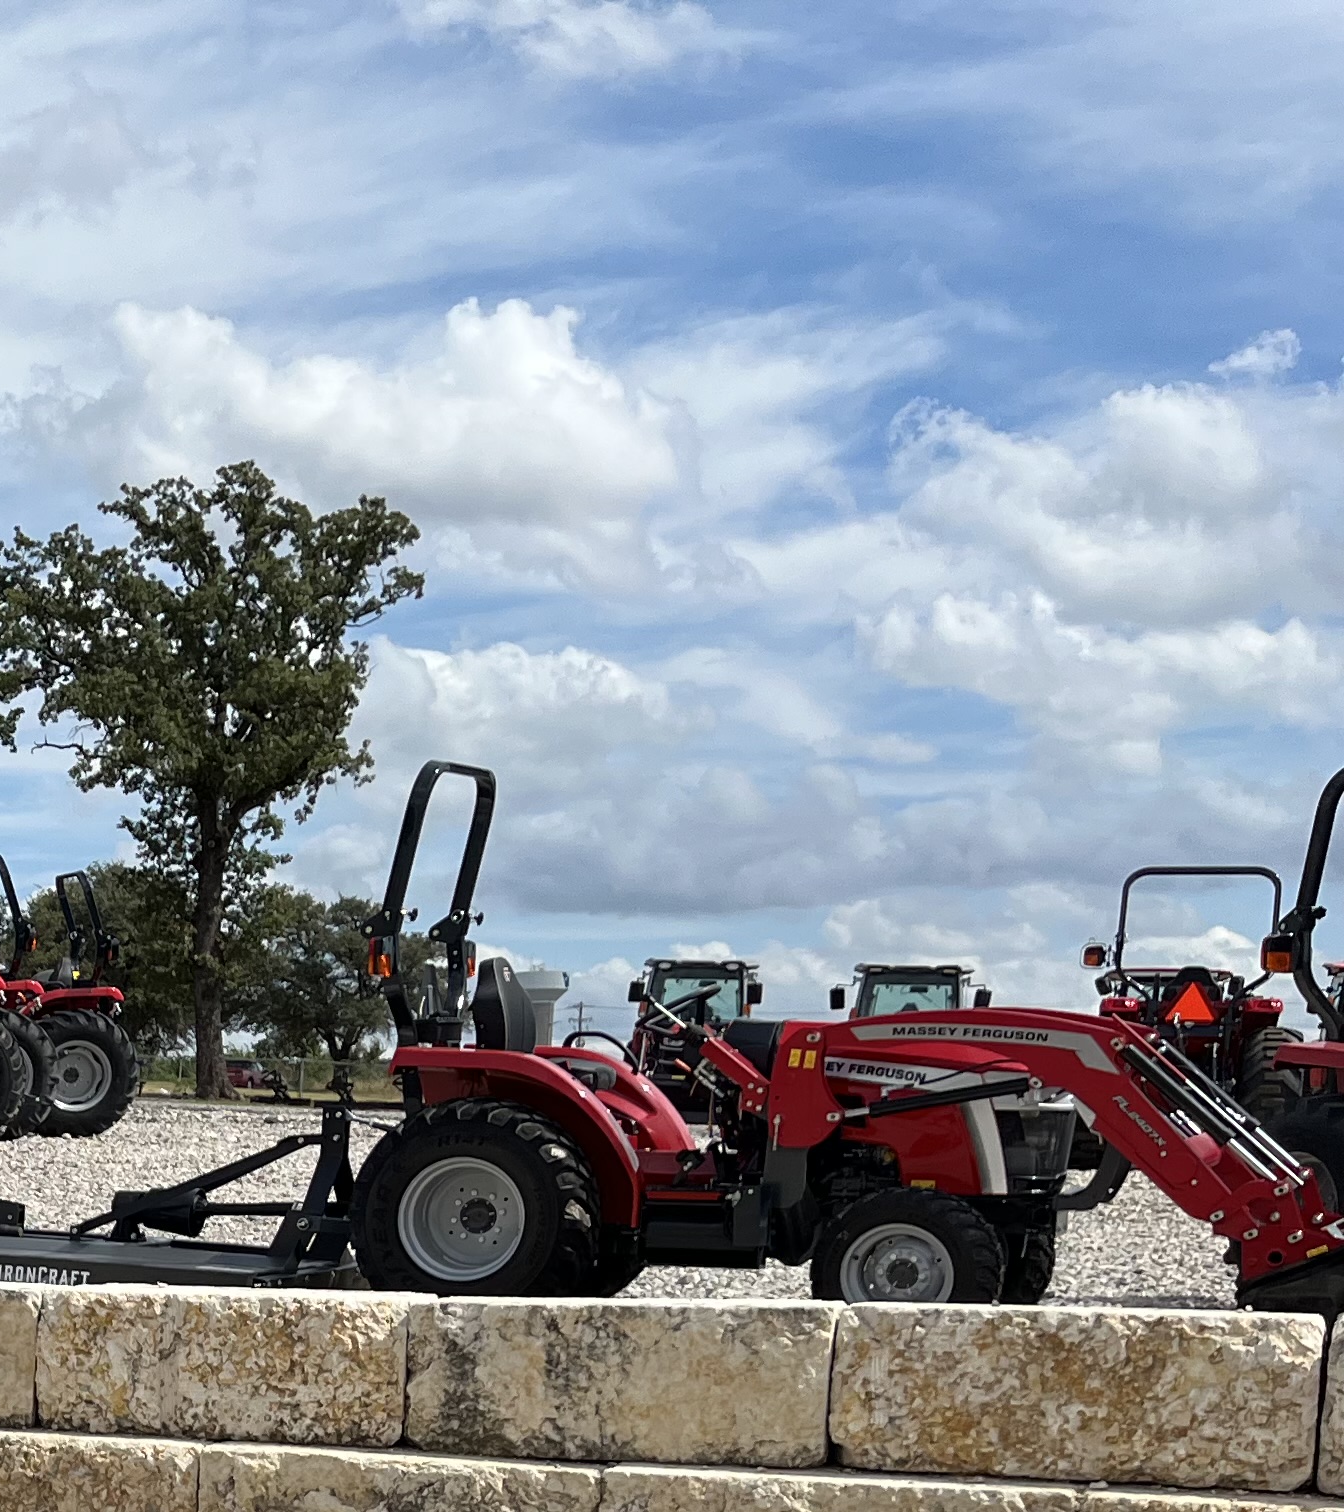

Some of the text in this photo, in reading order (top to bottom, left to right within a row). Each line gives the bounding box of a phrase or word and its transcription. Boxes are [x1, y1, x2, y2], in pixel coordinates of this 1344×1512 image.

[892, 1026, 1050, 1042] MASSEY FERGUSON
[848, 1063, 928, 1084] FERGUSON
